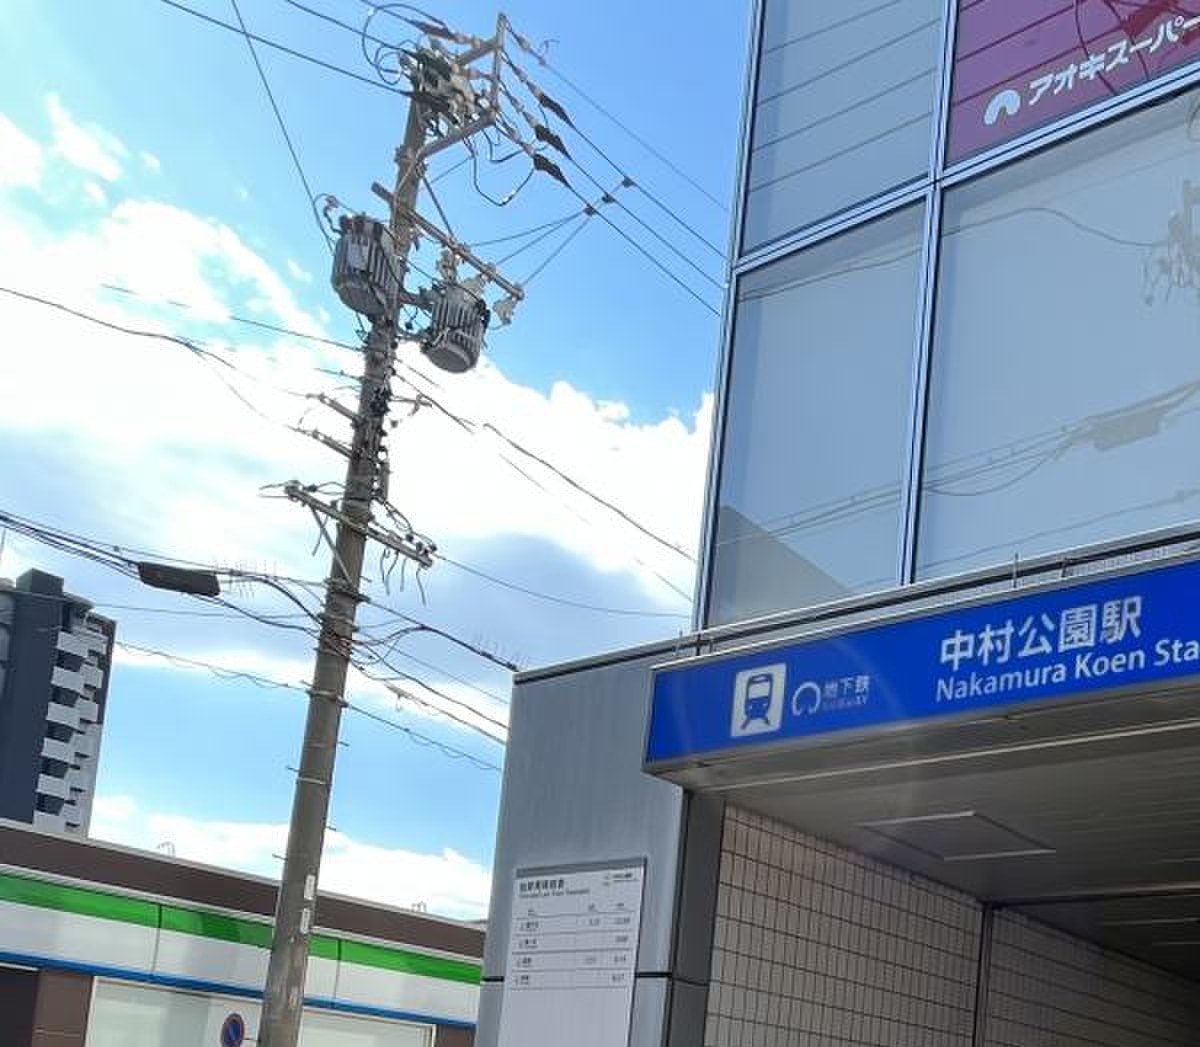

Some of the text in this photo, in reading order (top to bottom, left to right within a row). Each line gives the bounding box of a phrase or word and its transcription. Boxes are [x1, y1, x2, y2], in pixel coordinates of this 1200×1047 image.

[939, 595, 1144, 673] 中村公園駅
[936, 662, 1067, 703] Nakamura
[1074, 649, 1146, 679] Koen
